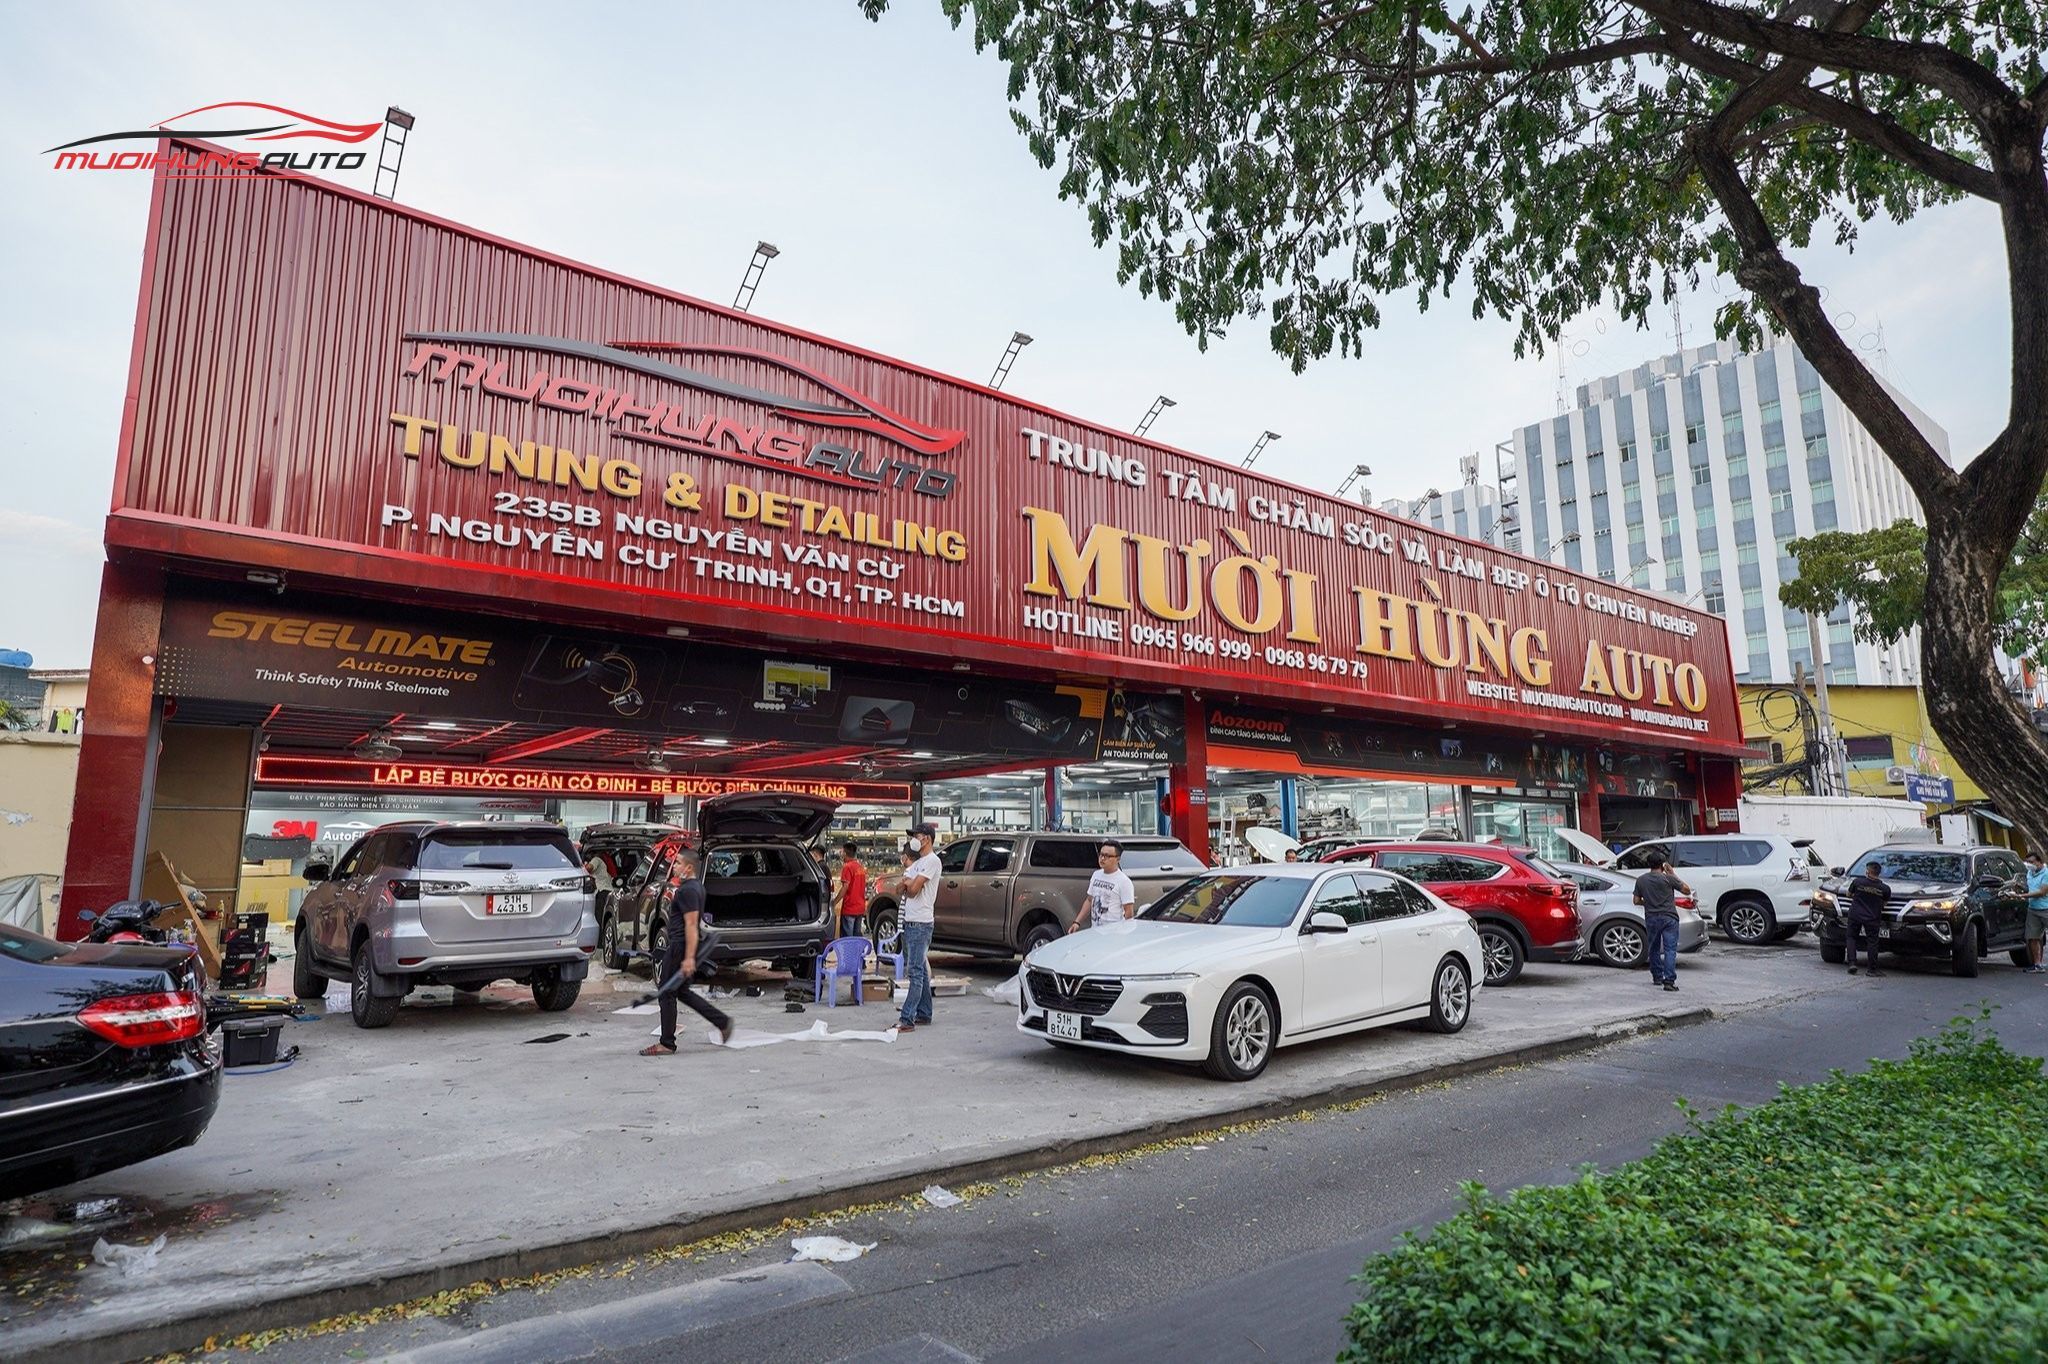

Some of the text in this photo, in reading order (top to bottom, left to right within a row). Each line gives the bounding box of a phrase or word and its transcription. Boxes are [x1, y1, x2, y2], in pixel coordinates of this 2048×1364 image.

[391, 413, 967, 562] TUNING & DETAILING
[428, 512, 603, 560] NGUYỄN
[619, 545, 677, 570] CƯ
[494, 492, 905, 579] 235B NGUYỄN VĂN CỪ
[1022, 427, 1147, 486] TRUNG
[1162, 470, 1235, 512] TÂM
[1248, 495, 1335, 538] CHĂM
[1400, 534, 1431, 566] VÀ
[1437, 547, 1485, 581] LÀM
[1491, 565, 1529, 595] ĐẸP
[1534, 573, 1549, 597] Ô
[1554, 582, 1580, 606] TÔ
[1584, 591, 1647, 624] CHUYÊN
[1650, 610, 1698, 641] NGHIỆP
[1022, 506, 1707, 713] MƯỜI HÙNG AUTO
[207, 611, 494, 665] STEELMATE
[1130, 623, 1178, 650] 0965
[1181, 632, 1215, 656] 966
[1219, 638, 1251, 661] 999
[1264, 646, 1305, 669] 0968
[337, 656, 478, 682] Automotive
[255, 668, 450, 698] Think Safety Think Steelmate
[1522, 689, 1623, 718] MUOIHUNGAUTO.COM
[1210, 710, 1284, 733] Aozoom
[1113, 748, 1130, 758] TOÀN
[513, 771, 562, 789] CHÂN
[272, 820, 317, 841] 3M
[497, 903, 528, 913] 443.15
[504, 894, 522, 903] 51H
[1051, 1023, 1077, 1037] 814.47
[1057, 1013, 1071, 1025] 51H
